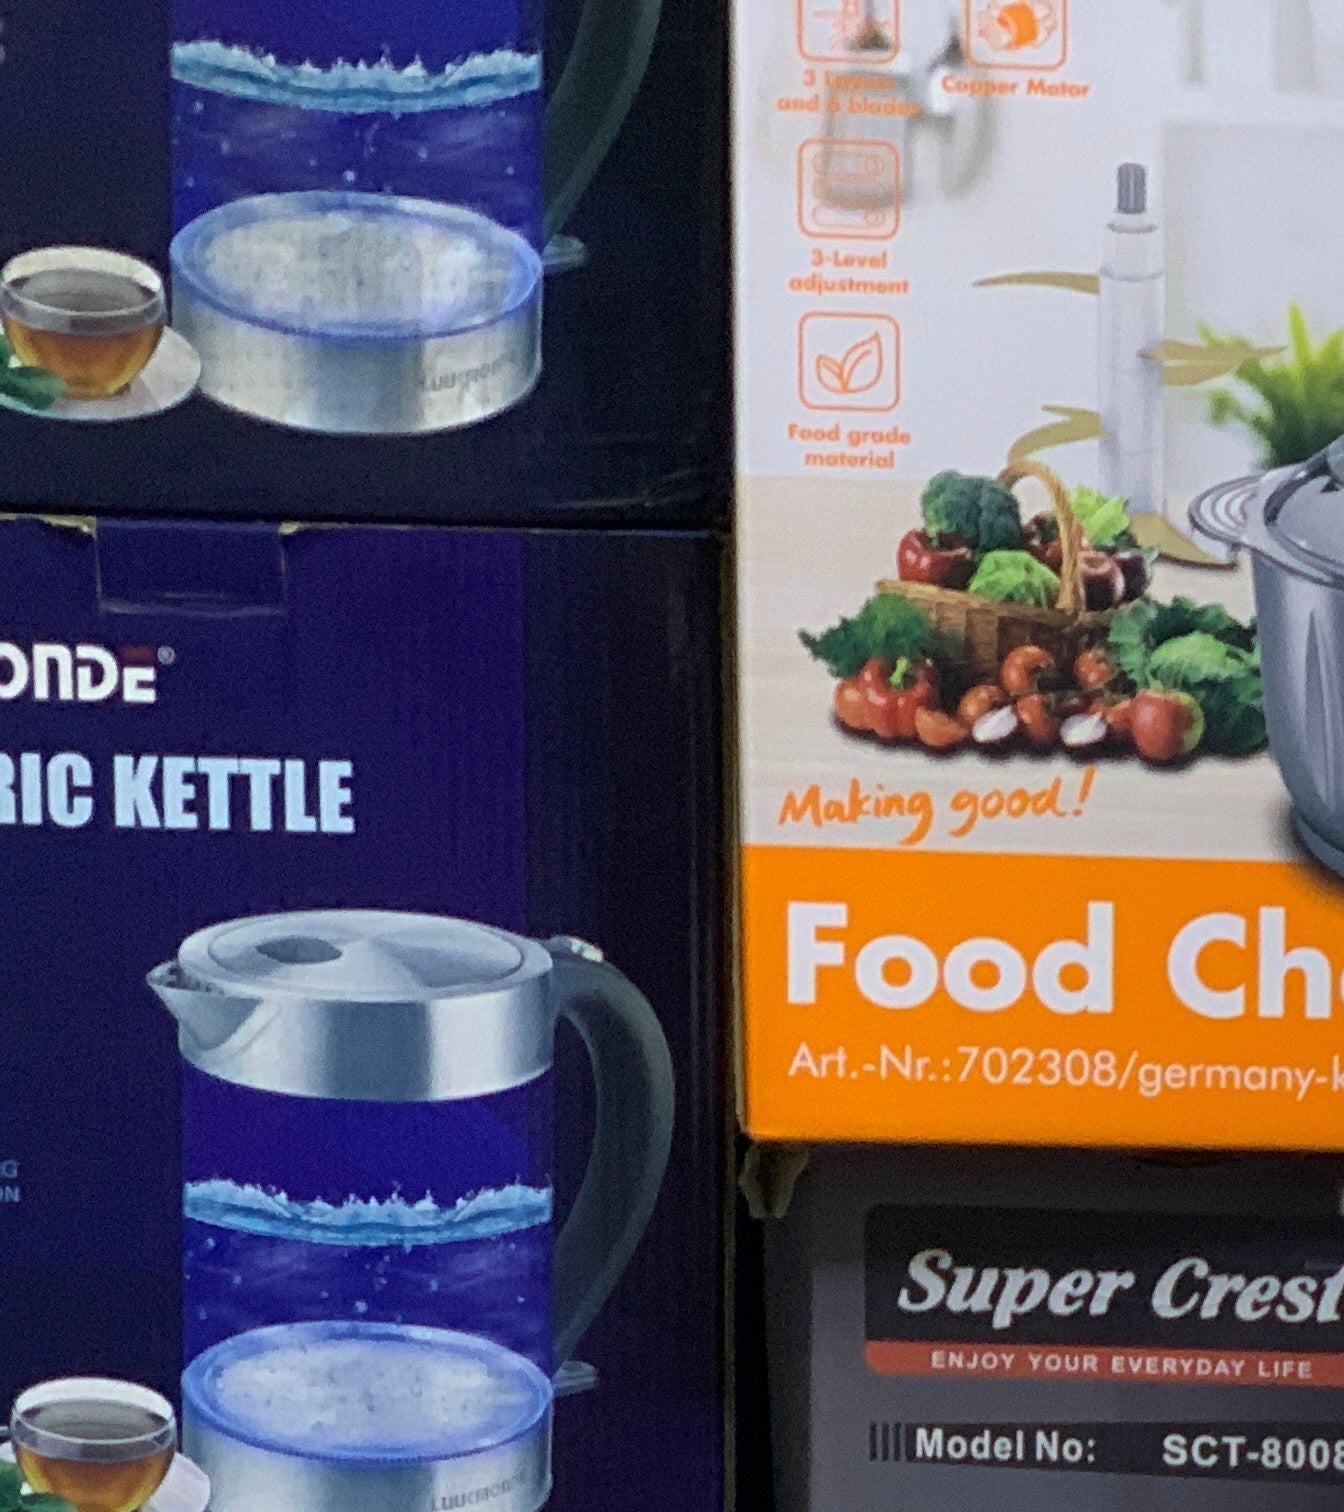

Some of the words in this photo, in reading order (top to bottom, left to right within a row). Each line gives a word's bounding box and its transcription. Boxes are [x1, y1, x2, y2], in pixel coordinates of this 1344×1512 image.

[941, 75, 1018, 98] Copper
[1026, 79, 1091, 98] Motor
[811, 248, 889, 270] 3-Level
[787, 273, 910, 297] adjustment
[787, 423, 841, 444] Food
[847, 426, 911, 448] grade
[804, 449, 895, 471] material
[113, 754, 356, 835] KETTLE
[778, 779, 934, 847] Making
[949, 766, 1098, 838] good!
[785, 900, 1117, 1016] Food
[897, 1247, 1137, 1330] Super
[931, 1350, 1015, 1371] ENJOY
[1028, 1352, 1100, 1374] YOUR
[1110, 1354, 1245, 1378] EVERYDAY
[1258, 1359, 1313, 1380] LIFE
[915, 1428, 1025, 1463] Model
[1036, 1431, 1097, 1464] No:
